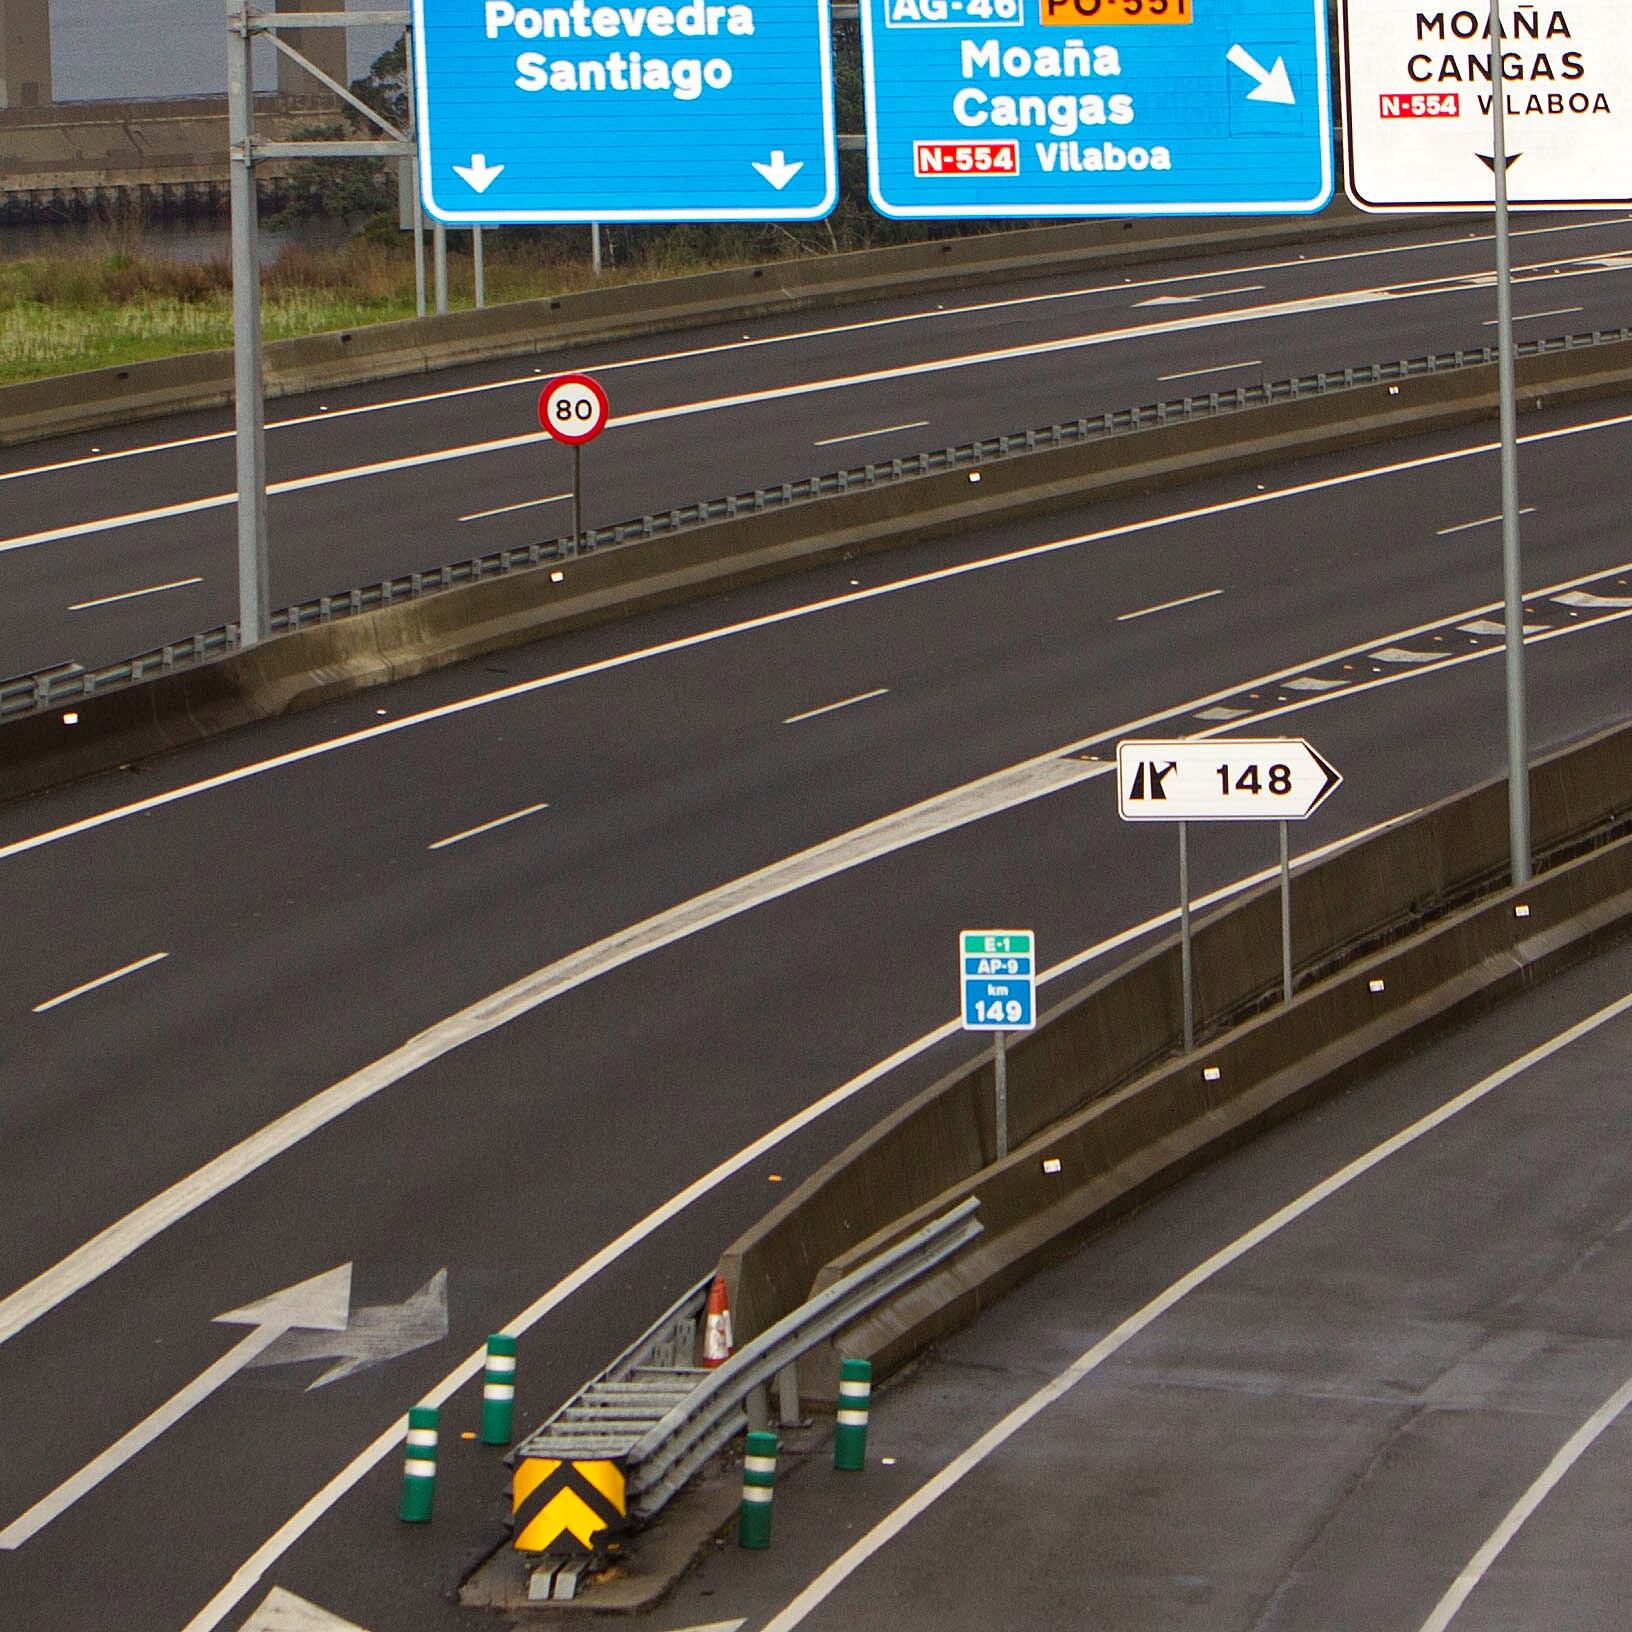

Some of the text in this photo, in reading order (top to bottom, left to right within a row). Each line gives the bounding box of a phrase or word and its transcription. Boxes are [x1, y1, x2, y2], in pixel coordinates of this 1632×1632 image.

[1416, 5, 1572, 41] MOAÑA
[961, 38, 1122, 79] Moaña
[1407, 51, 1585, 82] CANGAS
[515, 52, 733, 100] Santiago
[952, 88, 1135, 136] Cangas
[1381, 93, 1611, 116] N-554 VLABOA
[918, 141, 1172, 172] N-554 Vilaboa
[556, 399, 593, 421] 80
[1216, 764, 1292, 795] 148
[984, 936, 1010, 952] E-1
[977, 959, 1019, 974] AP-9
[987, 983, 1009, 996] km
[975, 1000, 1022, 1022] 149
